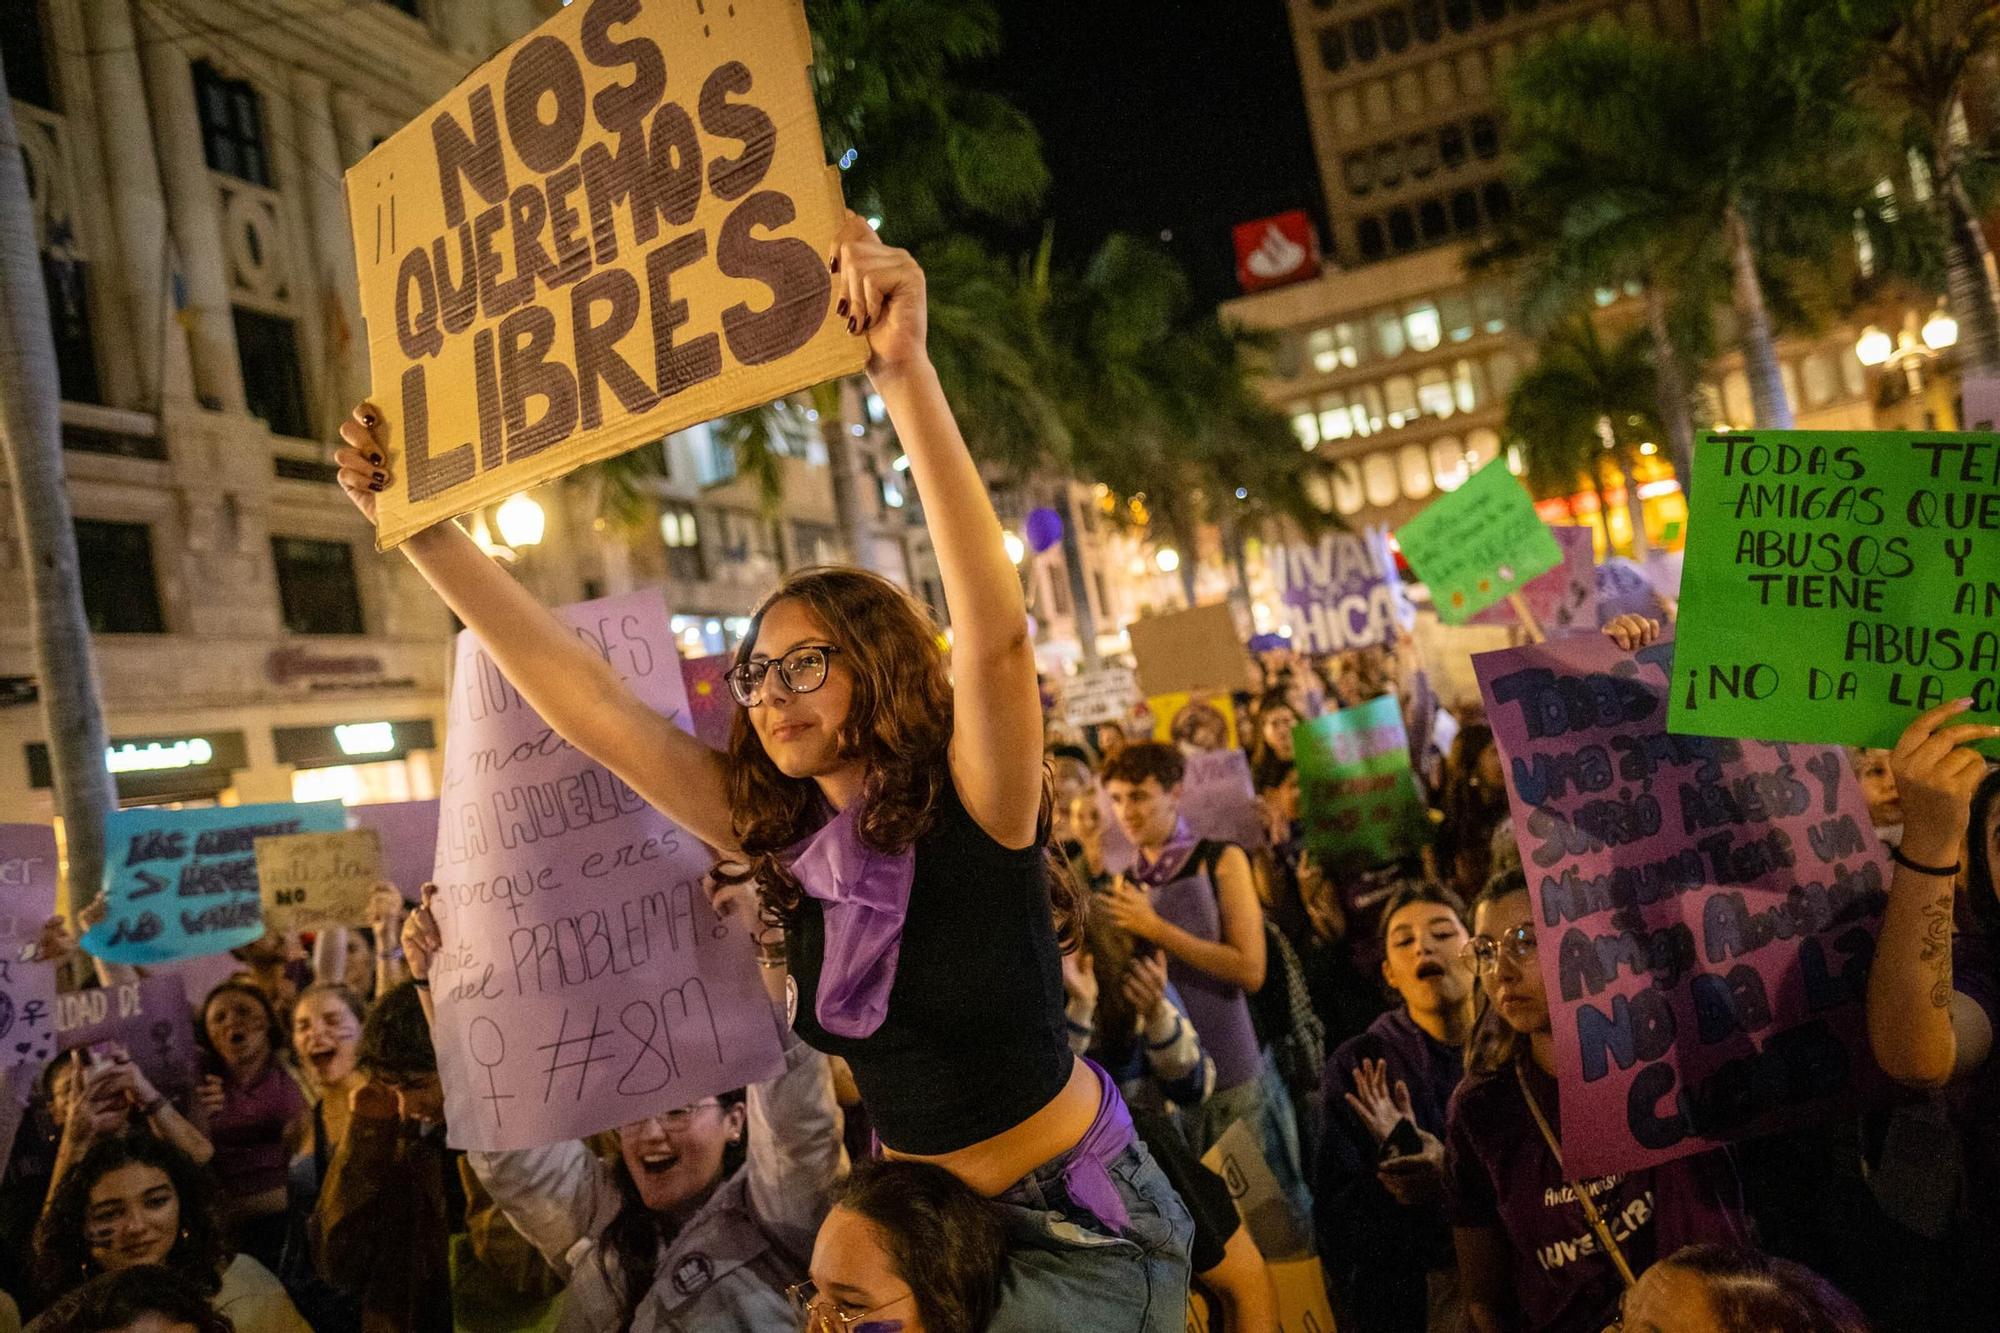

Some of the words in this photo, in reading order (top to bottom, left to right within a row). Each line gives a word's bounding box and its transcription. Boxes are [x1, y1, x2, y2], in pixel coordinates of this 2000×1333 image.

[431, 0, 667, 228] NOS
[395, 61, 776, 361] QUEREMOS
[401, 190, 832, 504] LIBRES
[1706, 436, 1866, 481] TODAS
[1719, 482, 1885, 526] AMIGAS
[1906, 489, 2000, 531] QUE
[1735, 530, 1915, 578] ABUSOS
[1944, 538, 1973, 578] Y
[1748, 574, 1888, 613] TIENE
[1844, 620, 2000, 672] ABUSA
[1685, 663, 1780, 710] ¡NO
[1808, 667, 1858, 700] DA
[1889, 673, 1944, 711] LA
[1969, 677, 2000, 713] C
[447, 801, 489, 865] LA
[492, 768, 647, 850] HUEL
[451, 867, 562, 937] porque
[581, 829, 680, 879] eres
[450, 963, 505, 1001] del
[537, 976, 723, 1104] #8M
